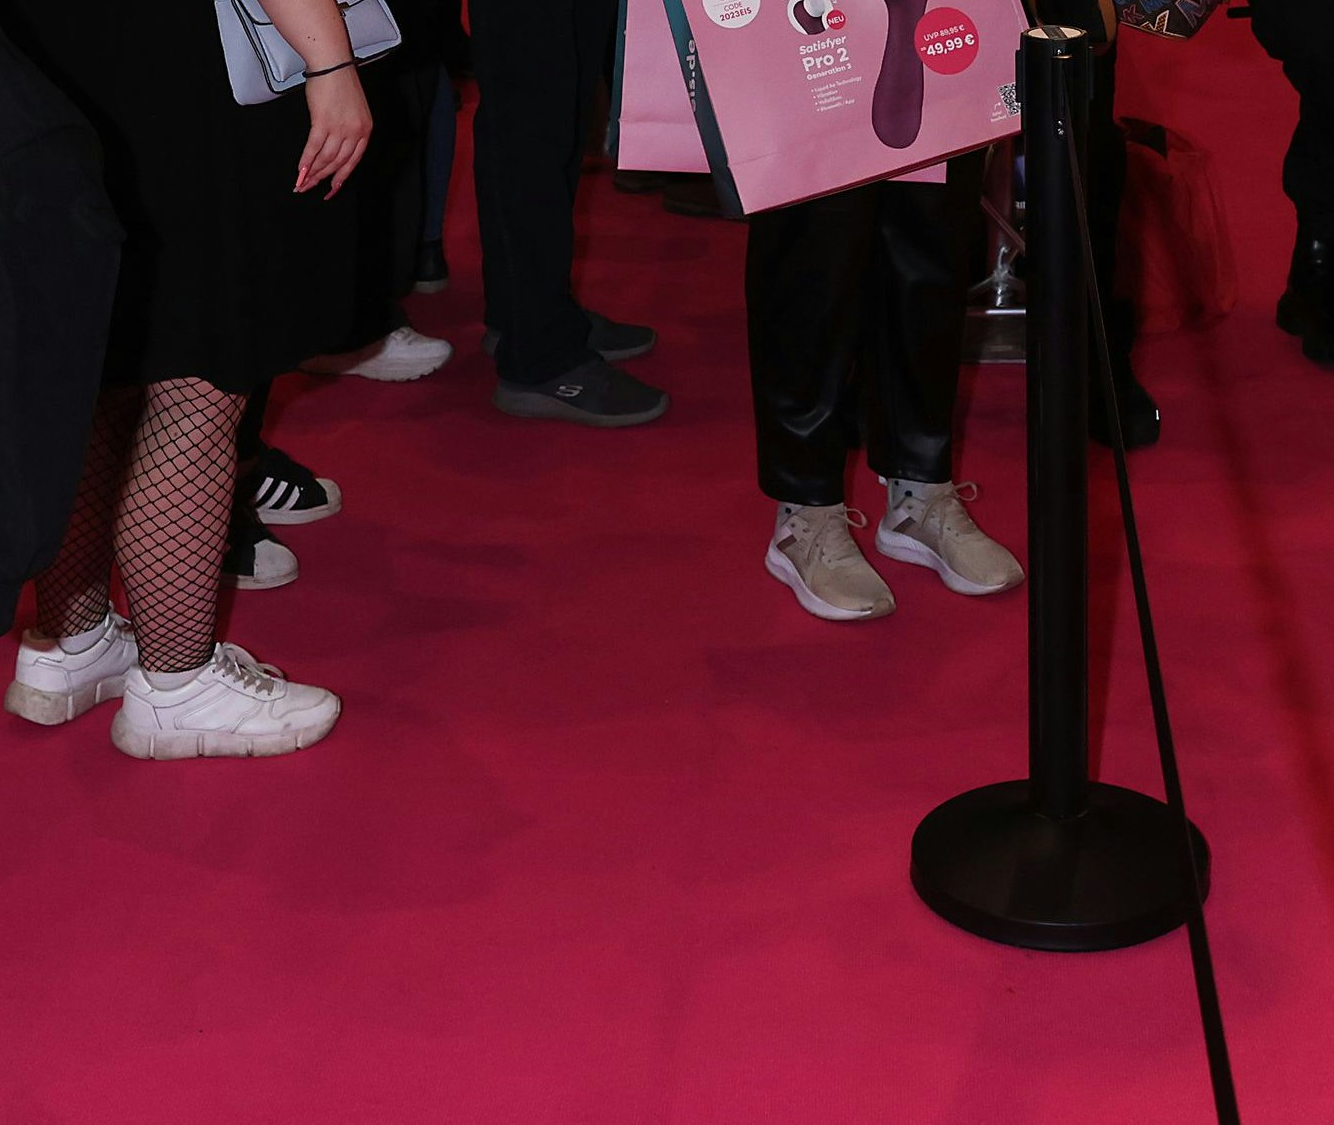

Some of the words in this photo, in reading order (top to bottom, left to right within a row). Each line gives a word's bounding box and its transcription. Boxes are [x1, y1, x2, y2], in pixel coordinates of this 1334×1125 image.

[719, 7, 752, 22] 2023EIS
[724, 1, 743, 13] CODE
[827, 15, 845, 26] NEU
[799, 36, 847, 55] Satisfyer
[926, 37, 963, 57] 49,99
[964, 34, 976, 46] €
[802, 54, 835, 72] Pro
[837, 47, 850, 63] 2
